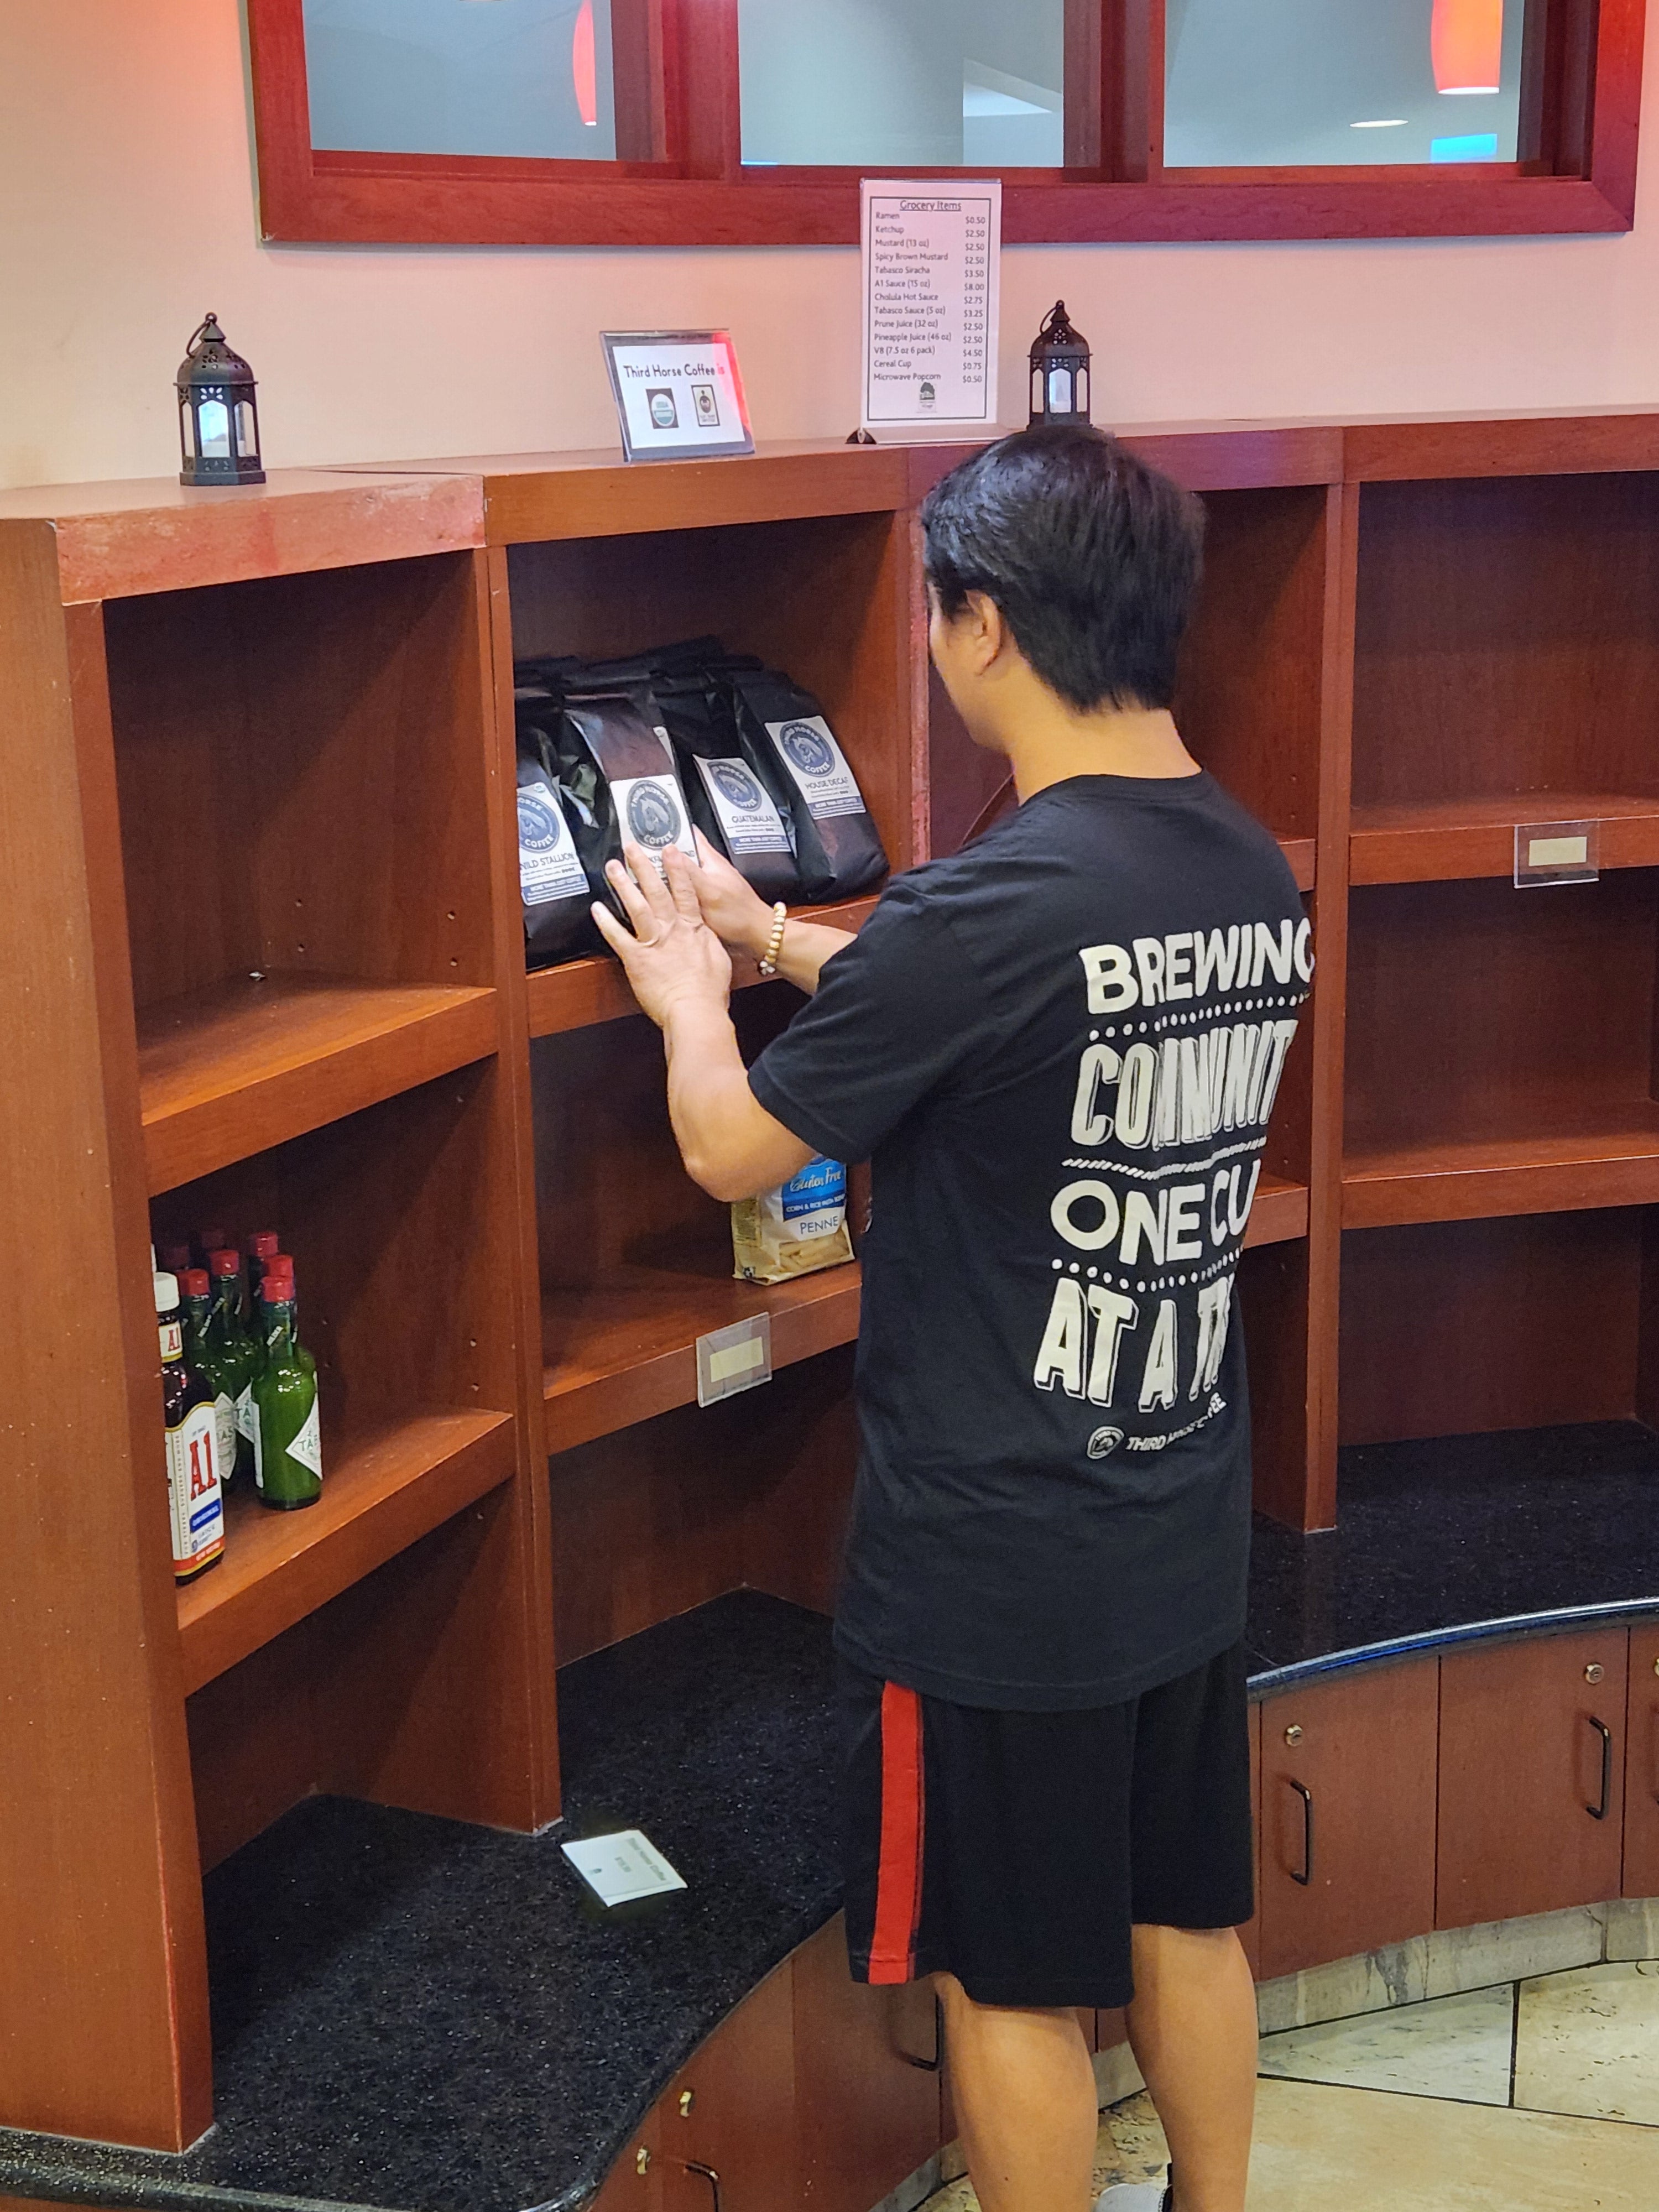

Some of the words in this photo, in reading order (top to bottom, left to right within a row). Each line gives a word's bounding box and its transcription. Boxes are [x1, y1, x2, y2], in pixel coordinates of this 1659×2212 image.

[900, 200, 935, 211] Grocery
[937, 201, 962, 211] Items
[875, 226, 904, 234] Ketchup
[906, 239, 917, 248] (13
[919, 239, 930, 248] oz)
[875, 253, 894, 262] Spicy
[920, 253, 948, 261] Mustard
[964, 257, 984, 265] $2.50
[964, 270, 984, 278] $3.50
[907, 279, 918, 289] (15
[920, 279, 931, 289] oz)
[964, 283, 984, 291] $8.00
[964, 296, 983, 305] $2.75
[874, 306, 902, 315] Tabasco
[926, 306, 933, 315] (5
[935, 306, 946, 315] oz)
[964, 310, 983, 318] $3.25
[874, 320, 895, 328] Prune
[896, 320, 912, 328] Juice
[914, 320, 926, 329] (32
[927, 320, 938, 329] oz)
[963, 322, 983, 331] $2.50
[874, 333, 907, 342] Pineapple
[909, 333, 926, 342] Juice
[927, 333, 940, 342] (46
[941, 333, 952, 342] oz)
[963, 336, 983, 344] $2.50
[886, 346, 899, 356] (7.5
[916, 346, 935, 356] pack)
[963, 349, 983, 357] $4.50
[898, 360, 911, 369] Cup
[623, 364, 650, 378] Third
[653, 364, 682, 377] Horse
[684, 363, 715, 376] Coffee
[912, 373, 941, 382] Popcorn
[805, 780, 829, 790] HOUSE
[829, 776, 848, 787] DECAF
[540, 852, 575, 866] STALLION
[790, 1174, 823, 1192] Gluten
[825, 1167, 841, 1185] Free
[1050, 1178, 1206, 1266] ONE
[1210, 1159, 1261, 1237] CU
[800, 1215, 838, 1234] PENNE
[1033, 1277, 1139, 1408] AT
[1138, 1298, 1178, 1413] A
[1125, 1435, 1167, 1451] THIRD
